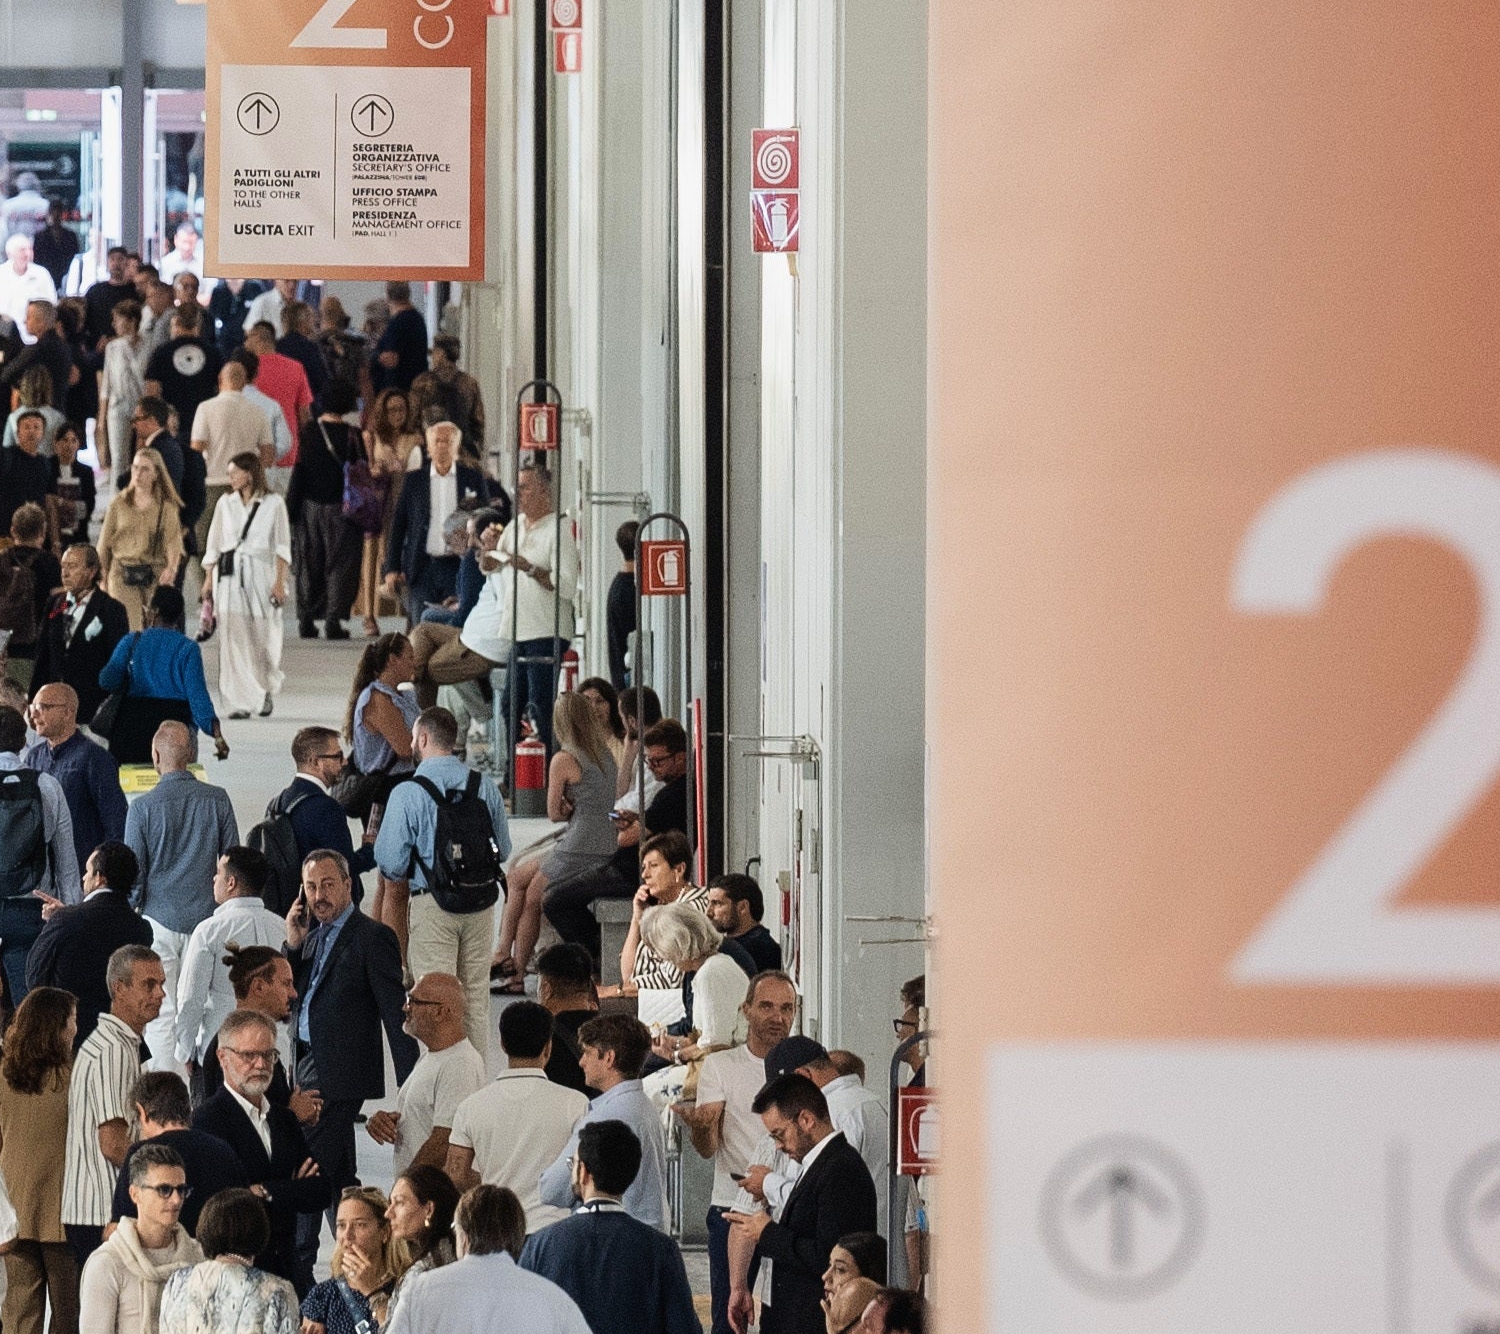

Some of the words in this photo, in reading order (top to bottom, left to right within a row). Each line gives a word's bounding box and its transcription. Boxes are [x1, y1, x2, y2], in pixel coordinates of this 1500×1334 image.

[352, 143, 414, 153] SEGRETERIA
[352, 153, 440, 162] ORGANIZZATIVA
[352, 163, 413, 172] SECRETARY'S
[415, 163, 451, 172] OFFICE
[233, 169, 241, 177] A
[244, 169, 271, 177] TUTTI
[274, 169, 291, 178] GLI
[293, 170, 321, 179] ALTRI
[233, 178, 294, 187] PADIGLIONI
[234, 190, 247, 198] TO
[249, 190, 267, 199] THE
[269, 190, 301, 199] OTHER
[352, 188, 393, 197] UFFICIO
[396, 188, 438, 197] STAMPA
[233, 199, 262, 208] HALLS
[352, 197, 380, 207] PRESS
[382, 198, 418, 207] OFFICE
[352, 211, 417, 220] PRESIDENZA
[352, 220, 423, 229] MANAGEMENT
[426, 220, 462, 229] OFFICE
[234, 223, 284, 236] USCITA
[288, 224, 315, 236] EXIT
